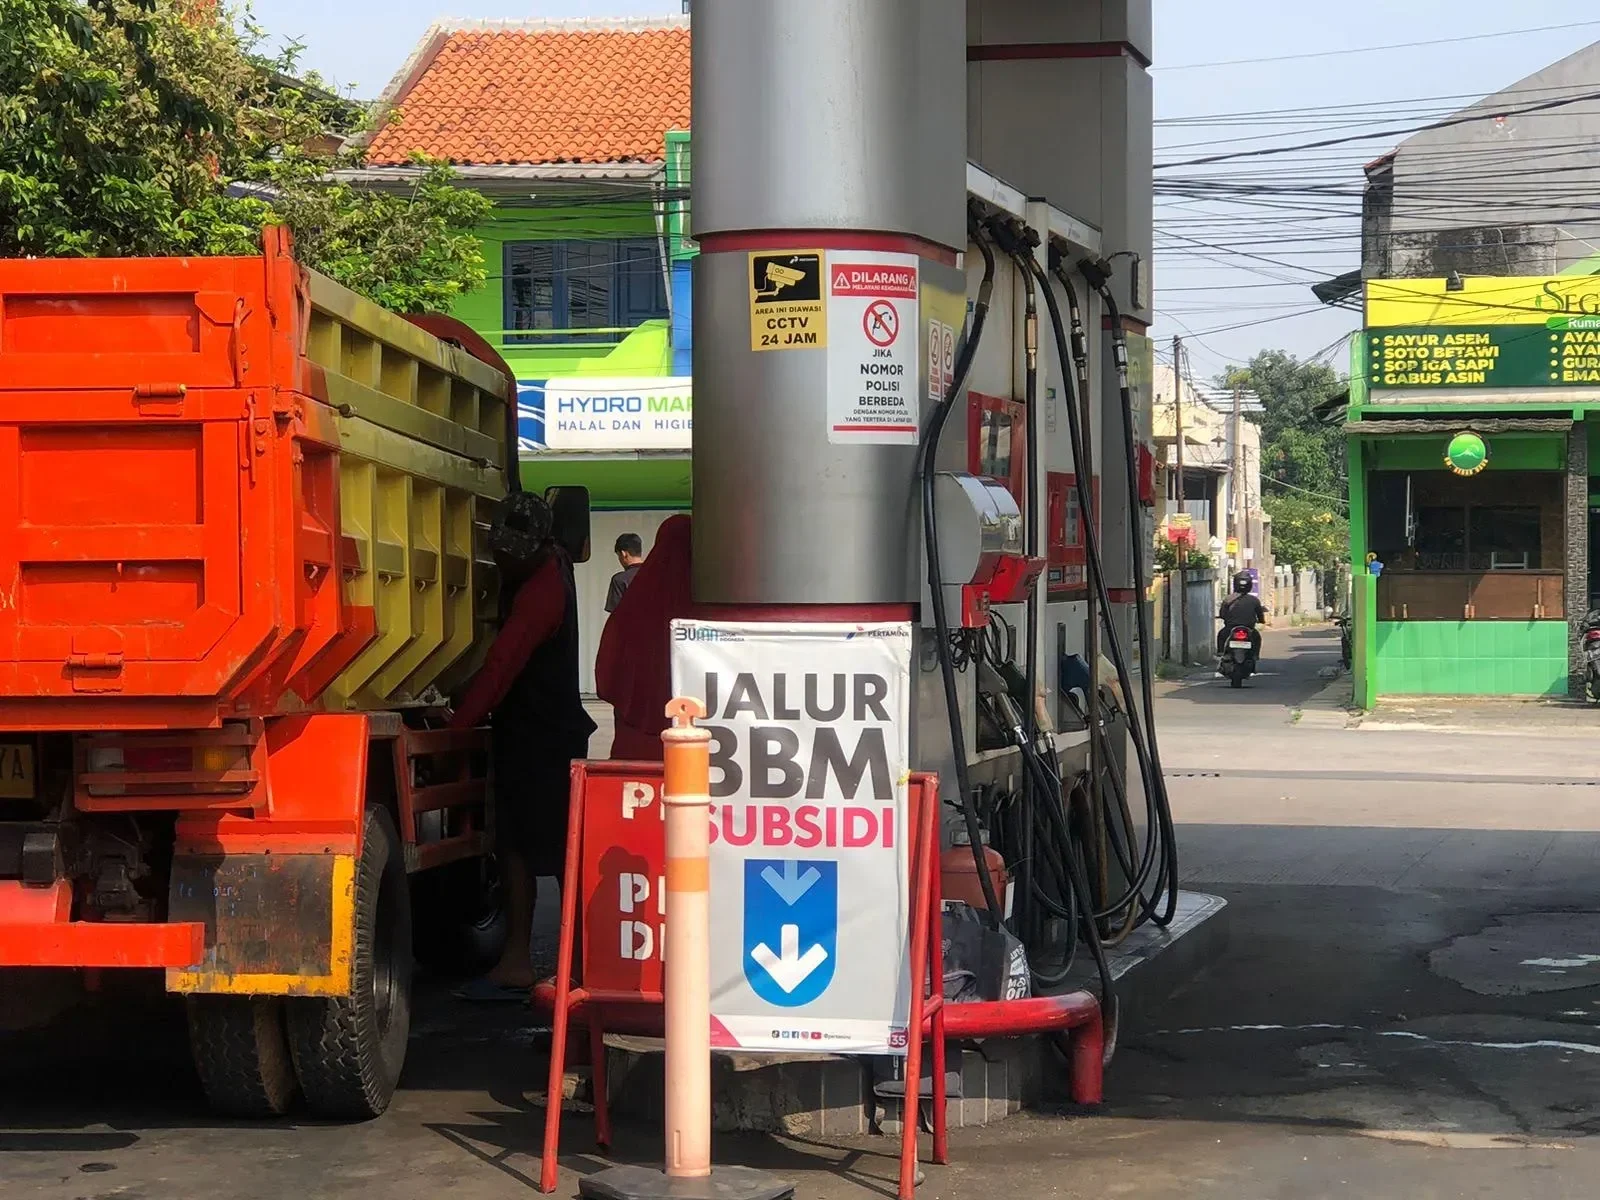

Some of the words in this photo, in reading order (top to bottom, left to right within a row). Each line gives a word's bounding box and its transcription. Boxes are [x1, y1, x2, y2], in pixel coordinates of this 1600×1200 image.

[851, 271, 909, 285] DILARANG
[789, 305, 822, 313] DIAWASI
[766, 316, 809, 330] CCTV
[761, 334, 779, 346] 24
[784, 332, 817, 344] JAM
[1384, 334, 1439, 347] SAYUR
[1442, 333, 1490, 345] ASEM
[1562, 332, 1600, 343] AYA
[872, 348, 893, 358] JIKA
[1384, 347, 1430, 359] SOTO
[1433, 346, 1500, 358] BETAWI
[1562, 344, 1600, 355] AYA
[860, 363, 904, 376] NOMOR
[1384, 360, 1419, 372] SOP
[1422, 359, 1452, 371] IGA
[1455, 359, 1495, 370] SAPI
[1562, 357, 1600, 369] GUR
[1384, 372, 1442, 385] GABUS
[1445, 371, 1486, 383] ASIN
[866, 380, 900, 391] POLISI
[558, 396, 642, 413] HYDRO
[859, 396, 905, 407] BERBEDA
[558, 420, 606, 431] HALAL
[612, 420, 641, 431] DAN
[868, 629, 910, 637] PERTAMINA
[697, 672, 892, 722] JALUR
